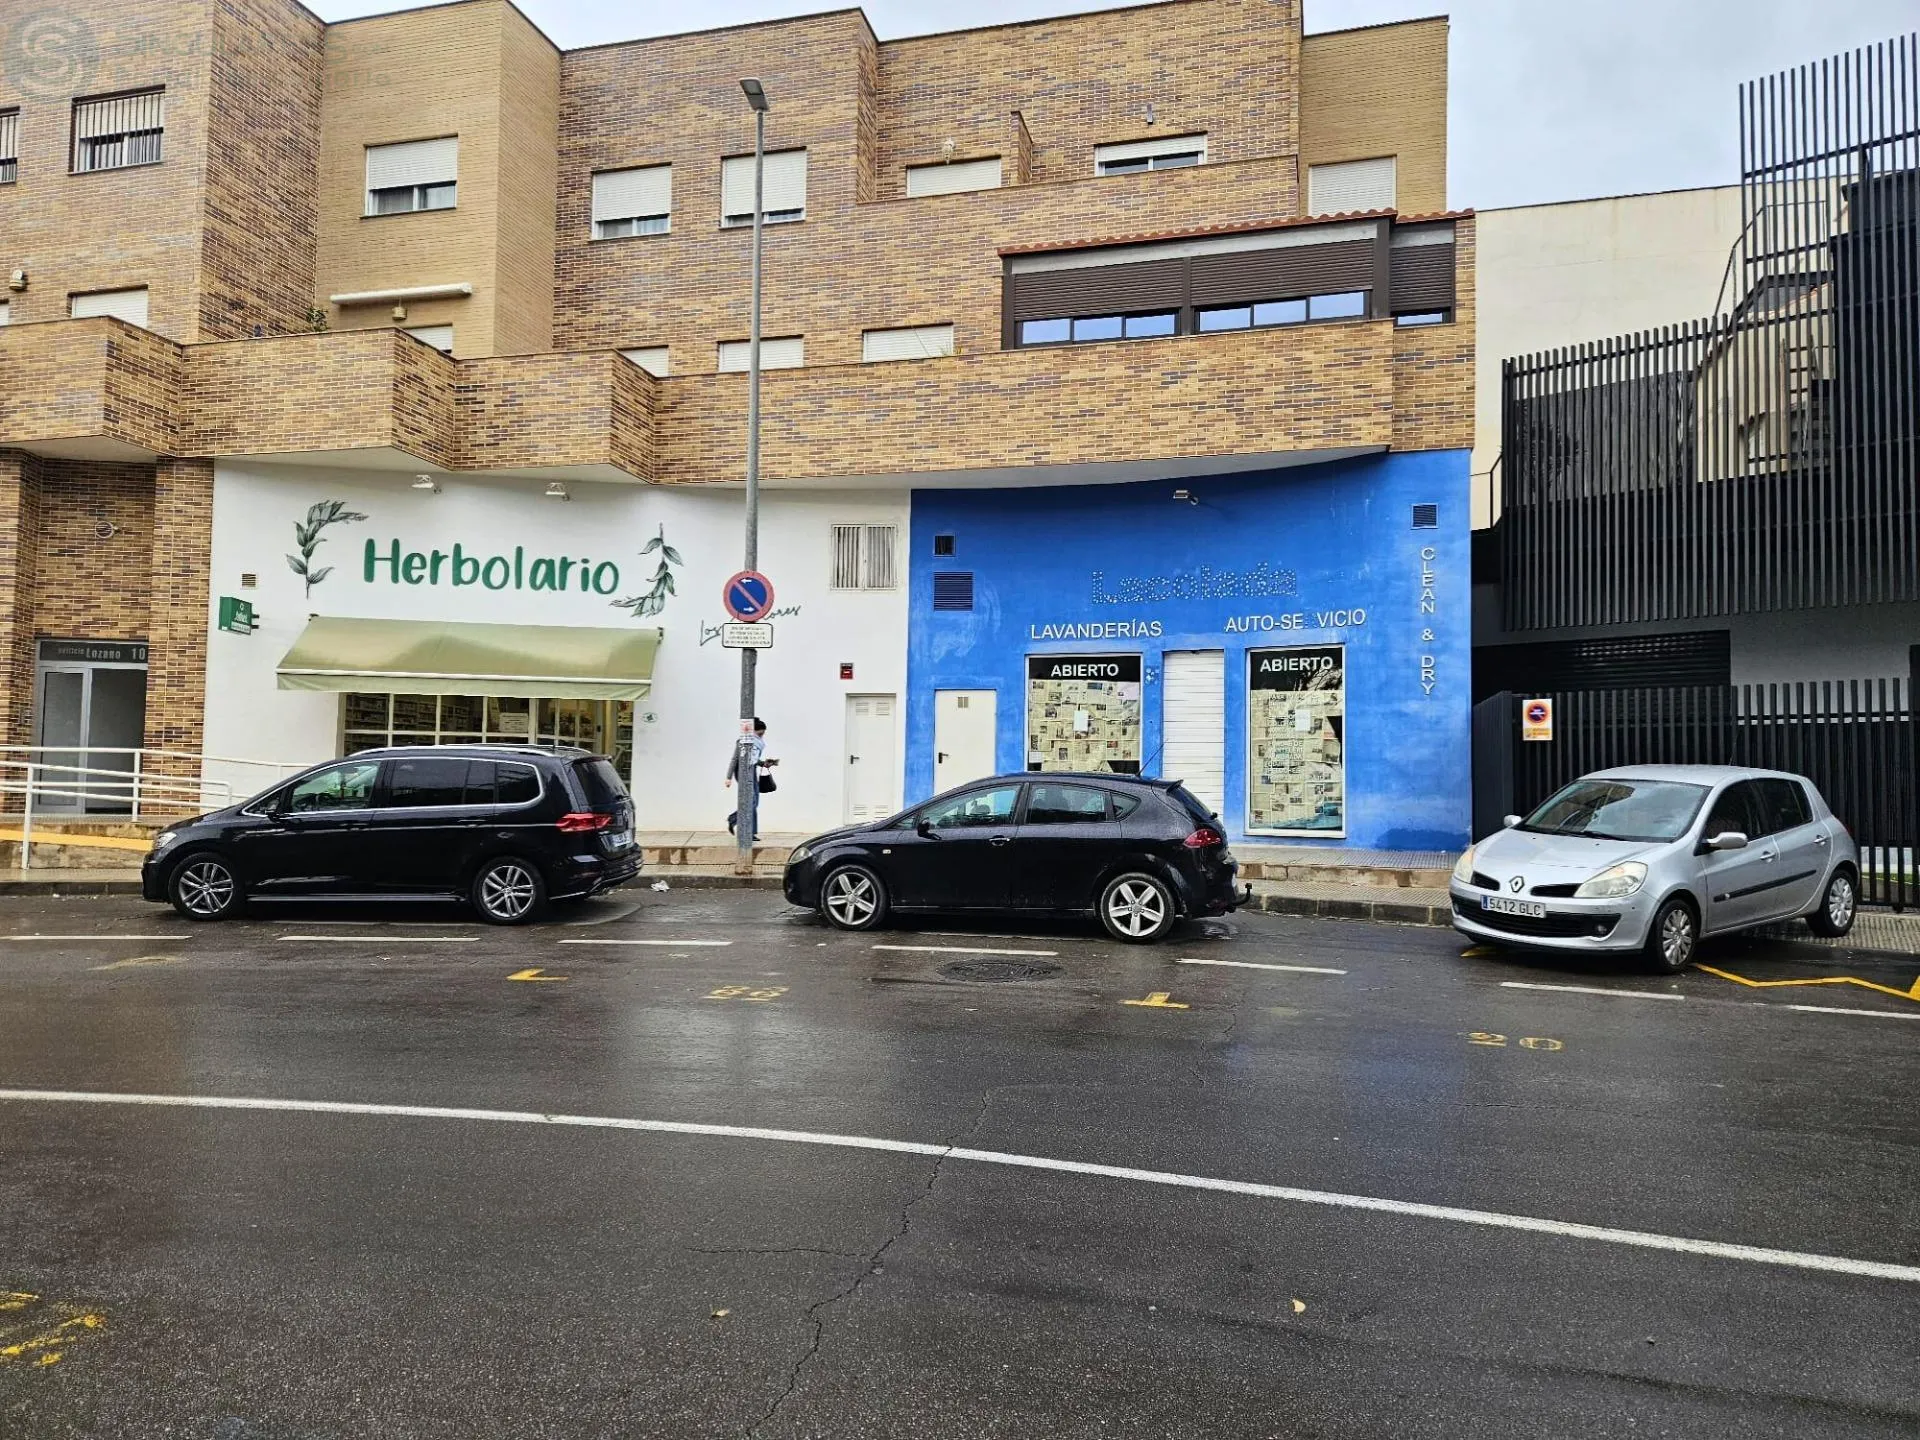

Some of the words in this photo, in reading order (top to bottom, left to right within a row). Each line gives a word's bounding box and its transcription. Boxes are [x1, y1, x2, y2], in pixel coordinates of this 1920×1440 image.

[363, 537, 620, 595] Herbolario
[1420, 547, 1435, 615] CLEAN
[1030, 618, 1163, 640] LAVANDERÍAS
[1421, 627, 1435, 641] &
[85, 647, 121, 660] Lozano
[131, 647, 146, 661] 10
[1050, 663, 1119, 677] ABIERTO
[1259, 656, 1334, 673] ABIERTO
[1420, 655, 1435, 695] DRY
[1489, 898, 1516, 913] 5412
[1519, 902, 1541, 916] GLC
